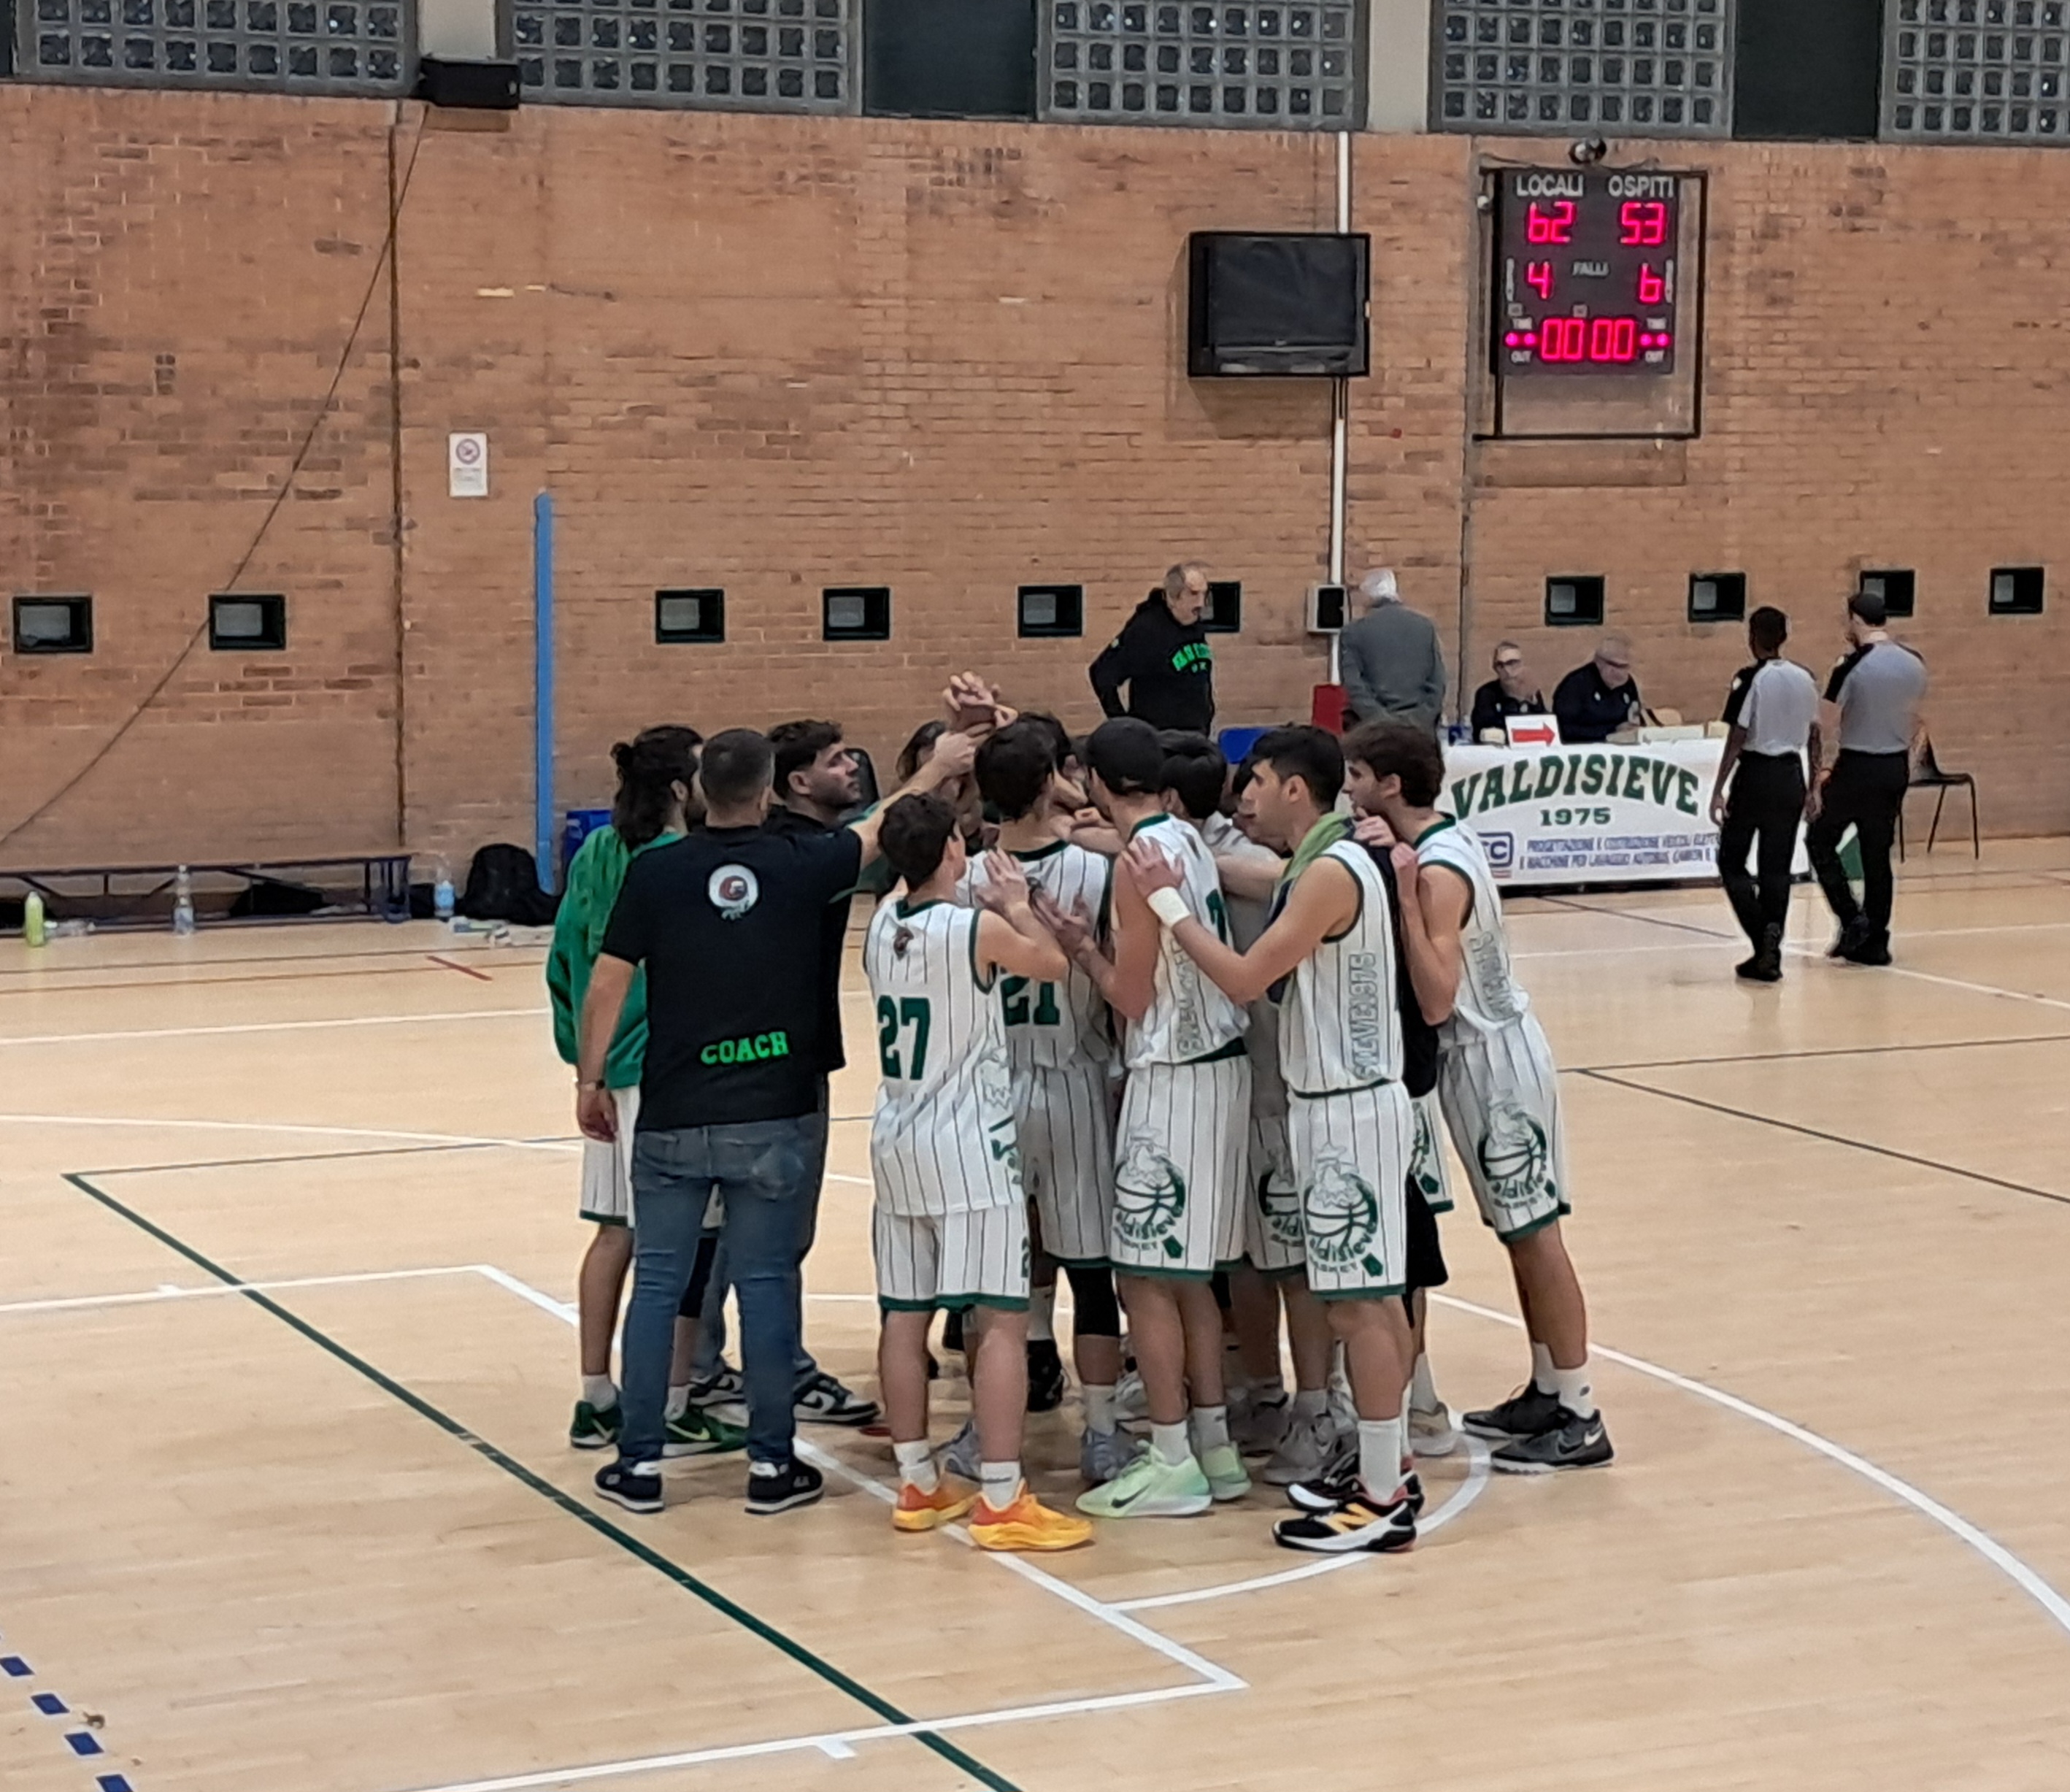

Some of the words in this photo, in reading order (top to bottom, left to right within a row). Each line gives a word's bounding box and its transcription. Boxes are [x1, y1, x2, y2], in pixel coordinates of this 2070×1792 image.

[1516, 174, 1584, 196] LOCALI
[1608, 174, 1674, 198] OSPITI
[1528, 201, 1575, 244] 62
[1620, 201, 1665, 244] 53
[1528, 261, 1550, 299] 4
[1451, 753, 1699, 821] VALDISIEVE
[1540, 807, 1612, 827] 1975
[701, 1031, 788, 1064] COACH
[877, 995, 931, 1081] 27
